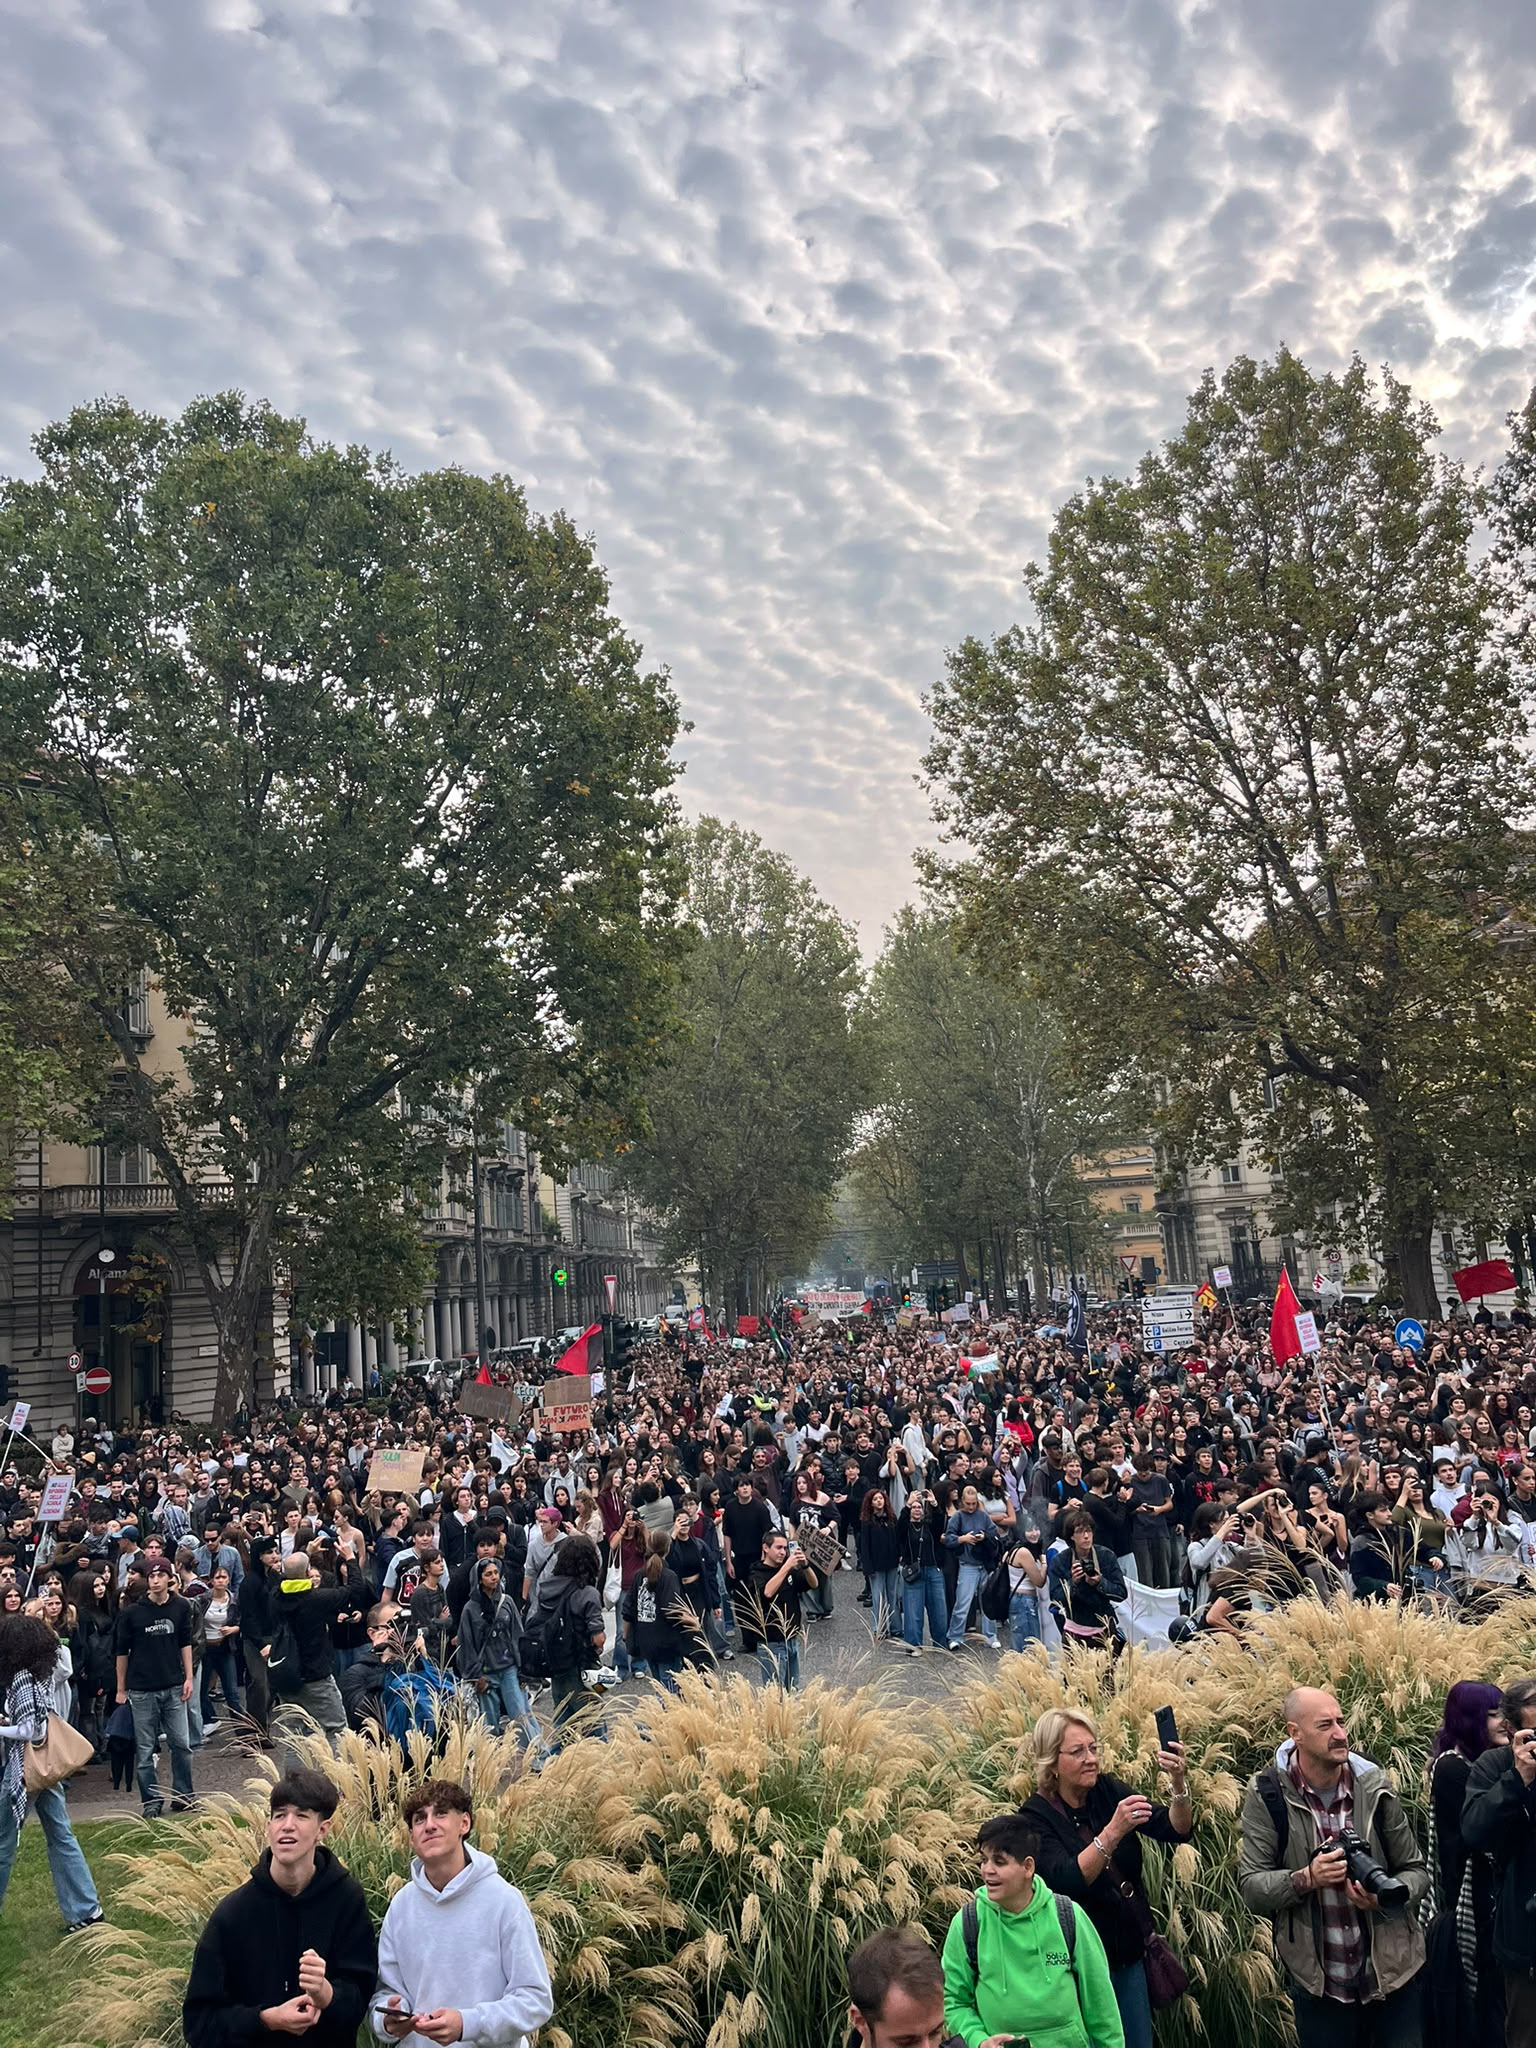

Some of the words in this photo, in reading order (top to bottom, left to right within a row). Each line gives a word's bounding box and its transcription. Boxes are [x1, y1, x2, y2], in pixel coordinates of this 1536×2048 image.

[553, 1404, 588, 1416] FUTURO
[539, 1416, 557, 1425] NON
[566, 1414, 588, 1423] ARMA
[145, 1624, 165, 1633] NORTH
